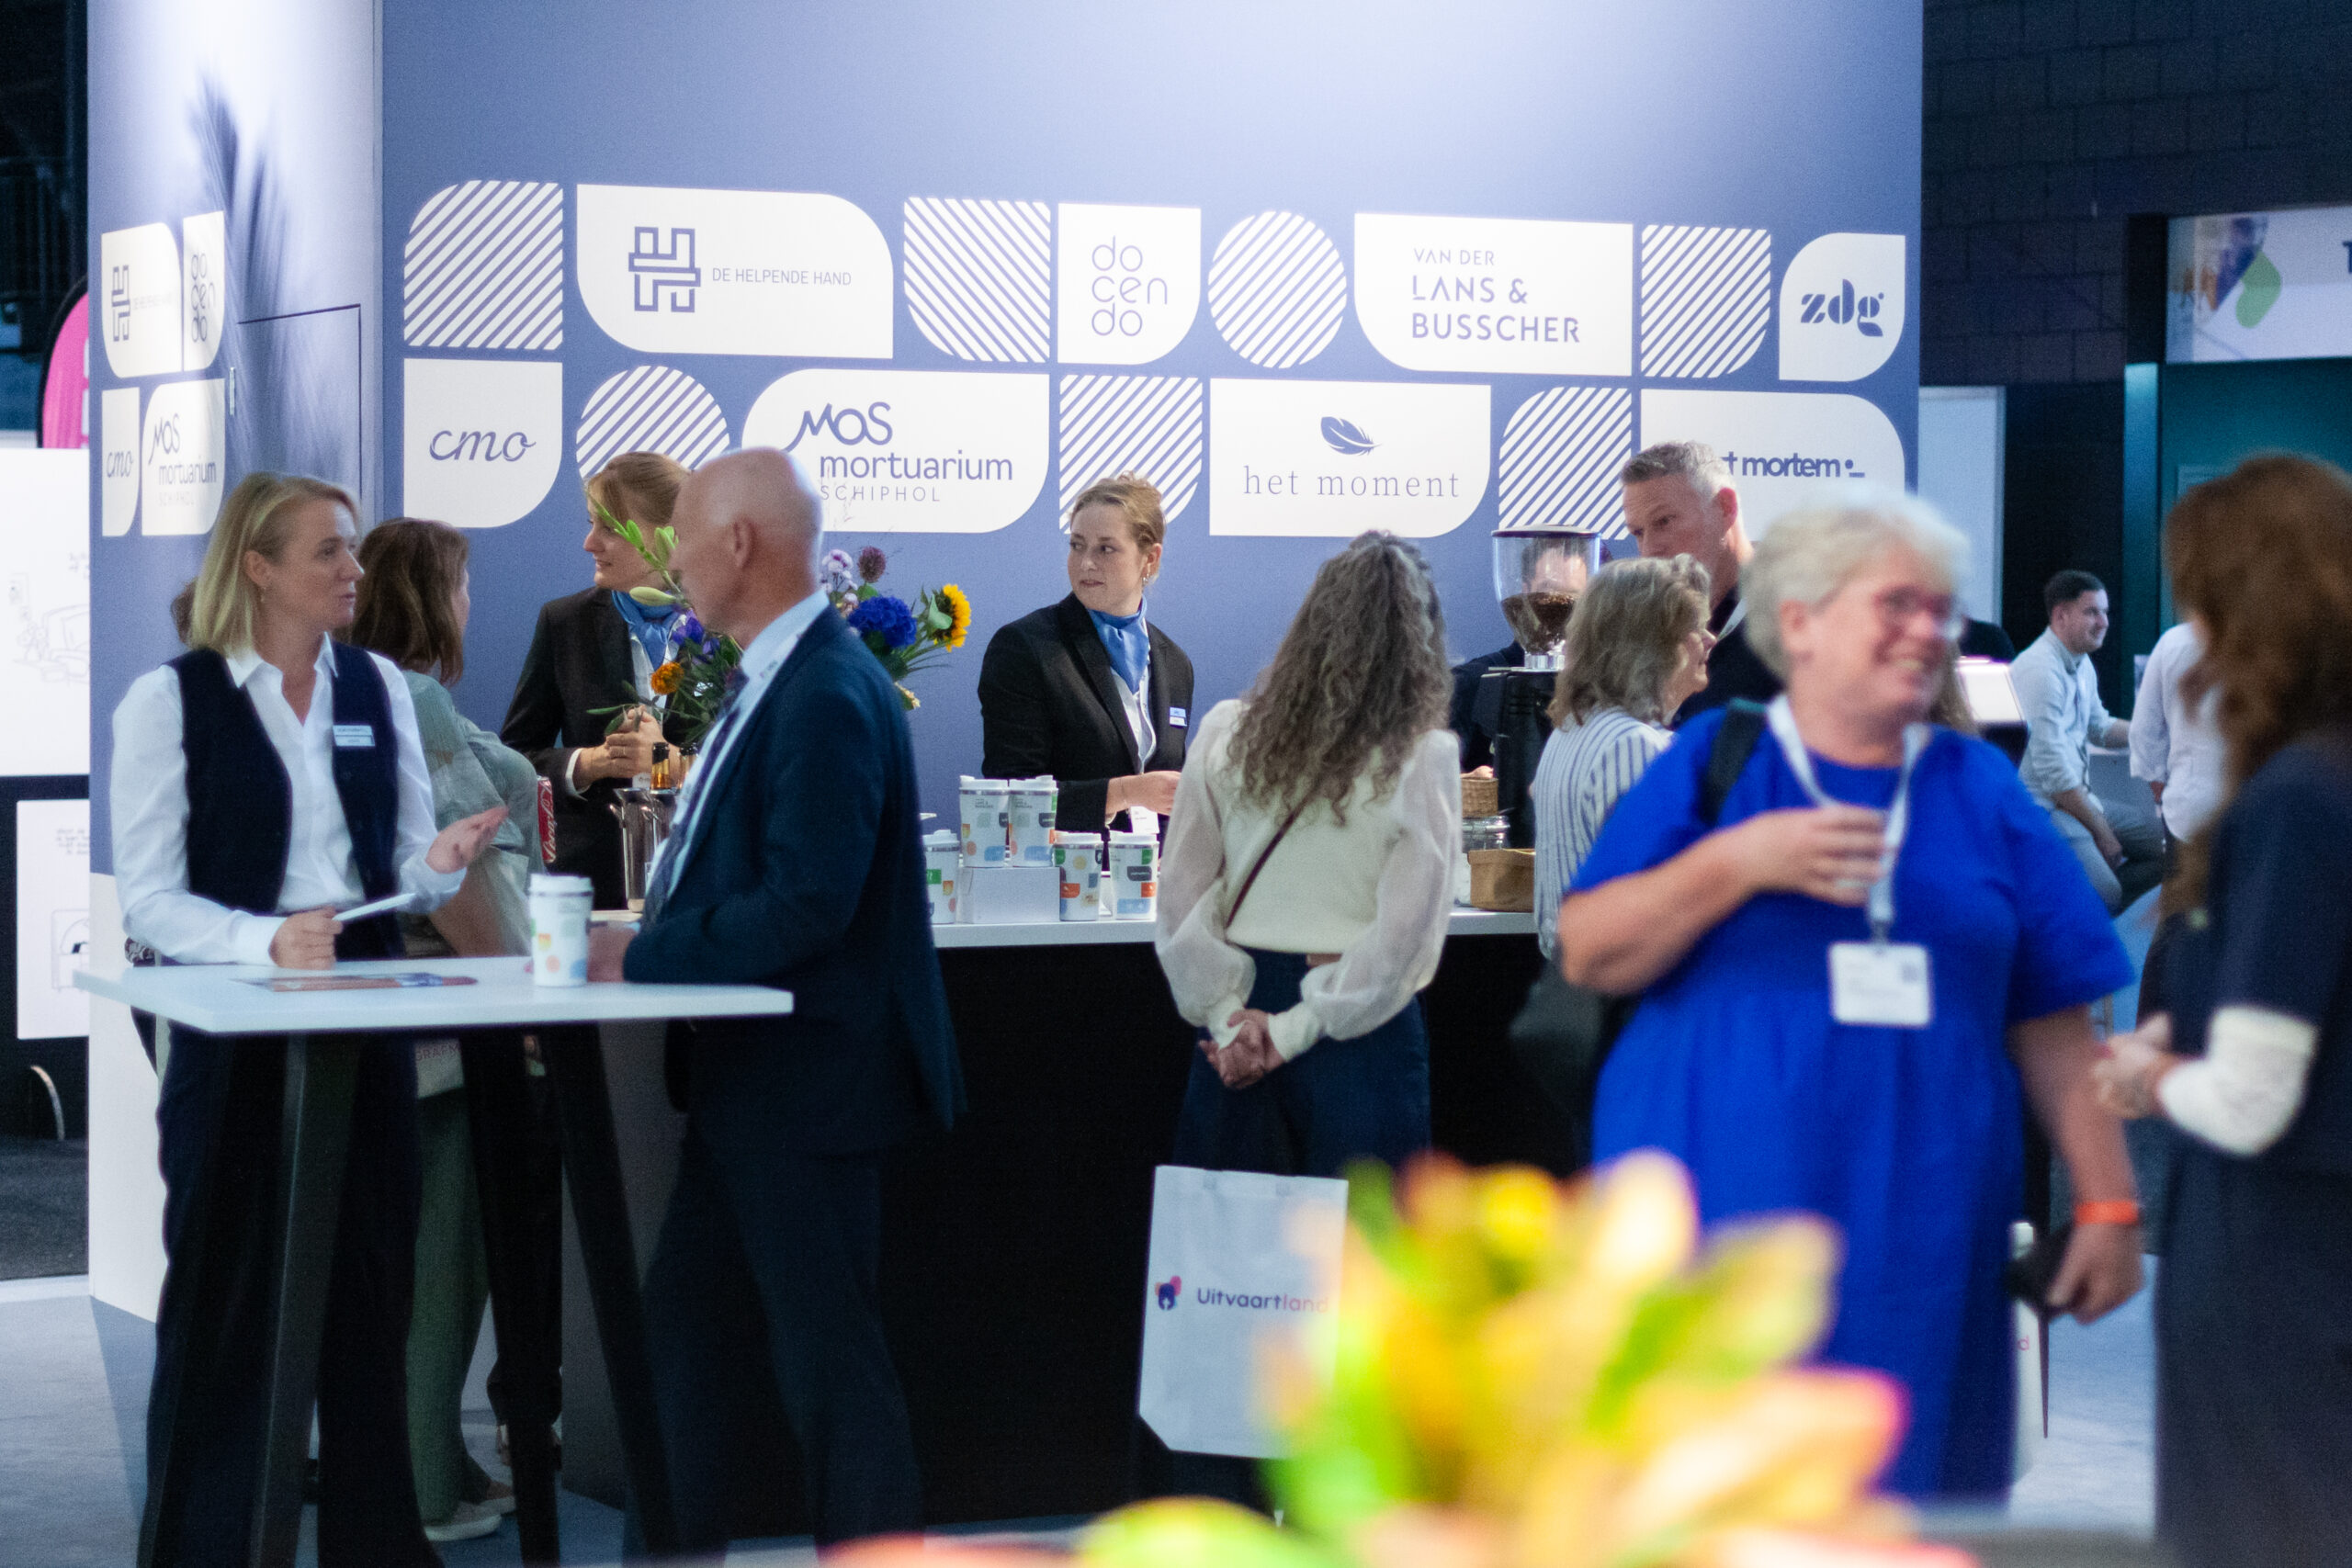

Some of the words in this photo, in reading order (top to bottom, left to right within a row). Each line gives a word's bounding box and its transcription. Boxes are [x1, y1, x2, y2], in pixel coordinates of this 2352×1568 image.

[1091, 236, 1145, 273] do
[1414, 248, 1453, 265] VAN
[1459, 249, 1496, 266] DER
[712, 267, 731, 283] DE
[736, 268, 809, 286] HELPENDE
[813, 272, 853, 288] HAND
[1091, 276, 1169, 305] cen
[1412, 275, 1497, 305] LANS
[1509, 277, 1530, 306] &
[1091, 301, 1145, 338] do
[1801, 278, 1885, 337] zdg
[1412, 312, 1581, 344] BUSSCHER
[429, 430, 537, 463] cmo
[107, 449, 133, 478] cmo
[159, 459, 217, 485] mortuarium
[820, 449, 1014, 480] mortuarium
[1742, 452, 1841, 479] mortem
[820, 485, 941, 502] SCHIPHOL
[1243, 465, 1300, 497] het
[1317, 473, 1460, 499] moment
[1197, 1288, 1329, 1313] Uitvaartland
